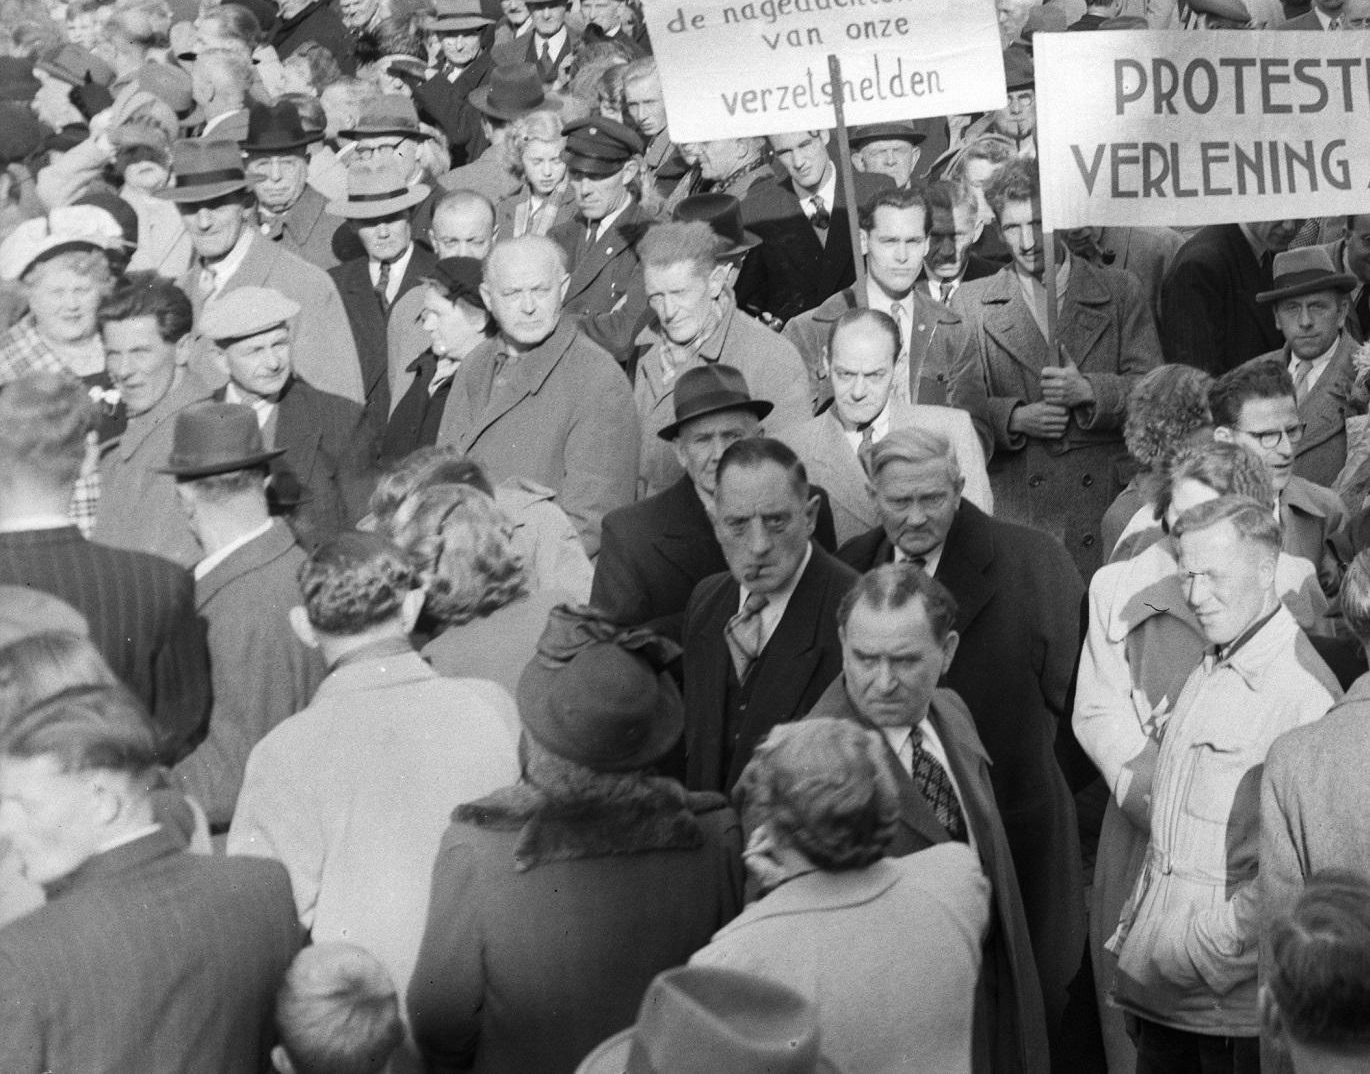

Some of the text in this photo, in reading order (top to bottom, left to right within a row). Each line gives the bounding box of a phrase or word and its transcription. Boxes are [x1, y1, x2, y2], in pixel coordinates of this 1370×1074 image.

[666, 8, 706, 34] de
[761, 17, 910, 51] van onze
[1070, 139, 1352, 199] VERLENING
